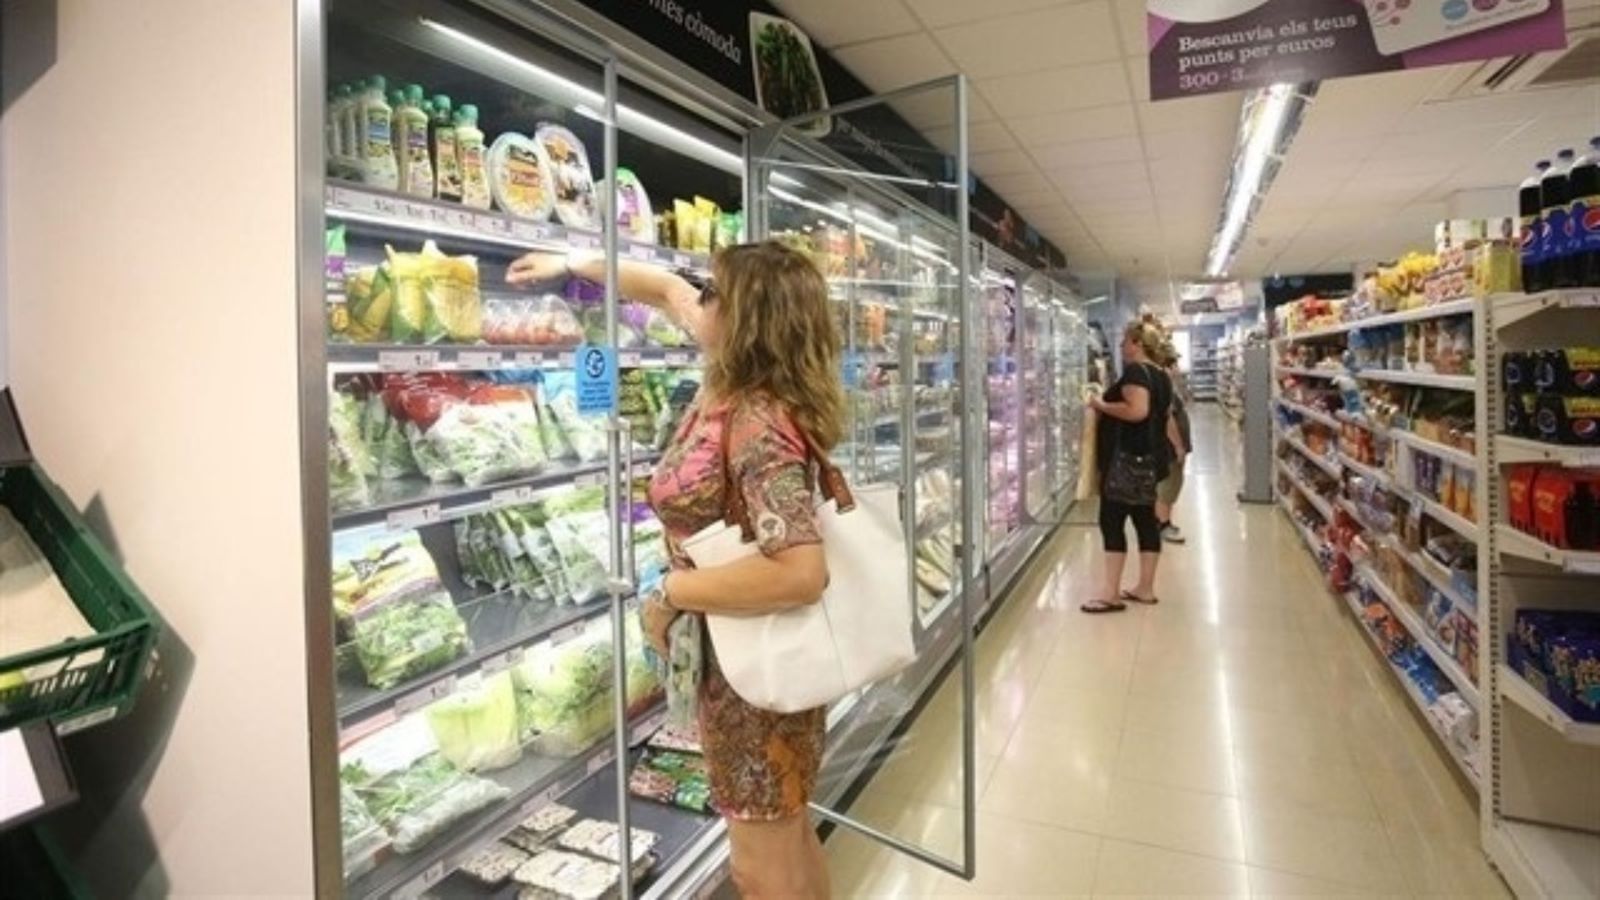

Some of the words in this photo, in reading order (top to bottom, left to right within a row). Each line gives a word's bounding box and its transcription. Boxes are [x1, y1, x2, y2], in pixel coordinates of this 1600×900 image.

[1178, 25, 1275, 52] Bescanvia
[1279, 20, 1308, 36] els
[1313, 14, 1358, 31] teus
[1178, 48, 1235, 73] punts
[1239, 44, 1273, 63] per
[1277, 35, 1335, 54] euros
